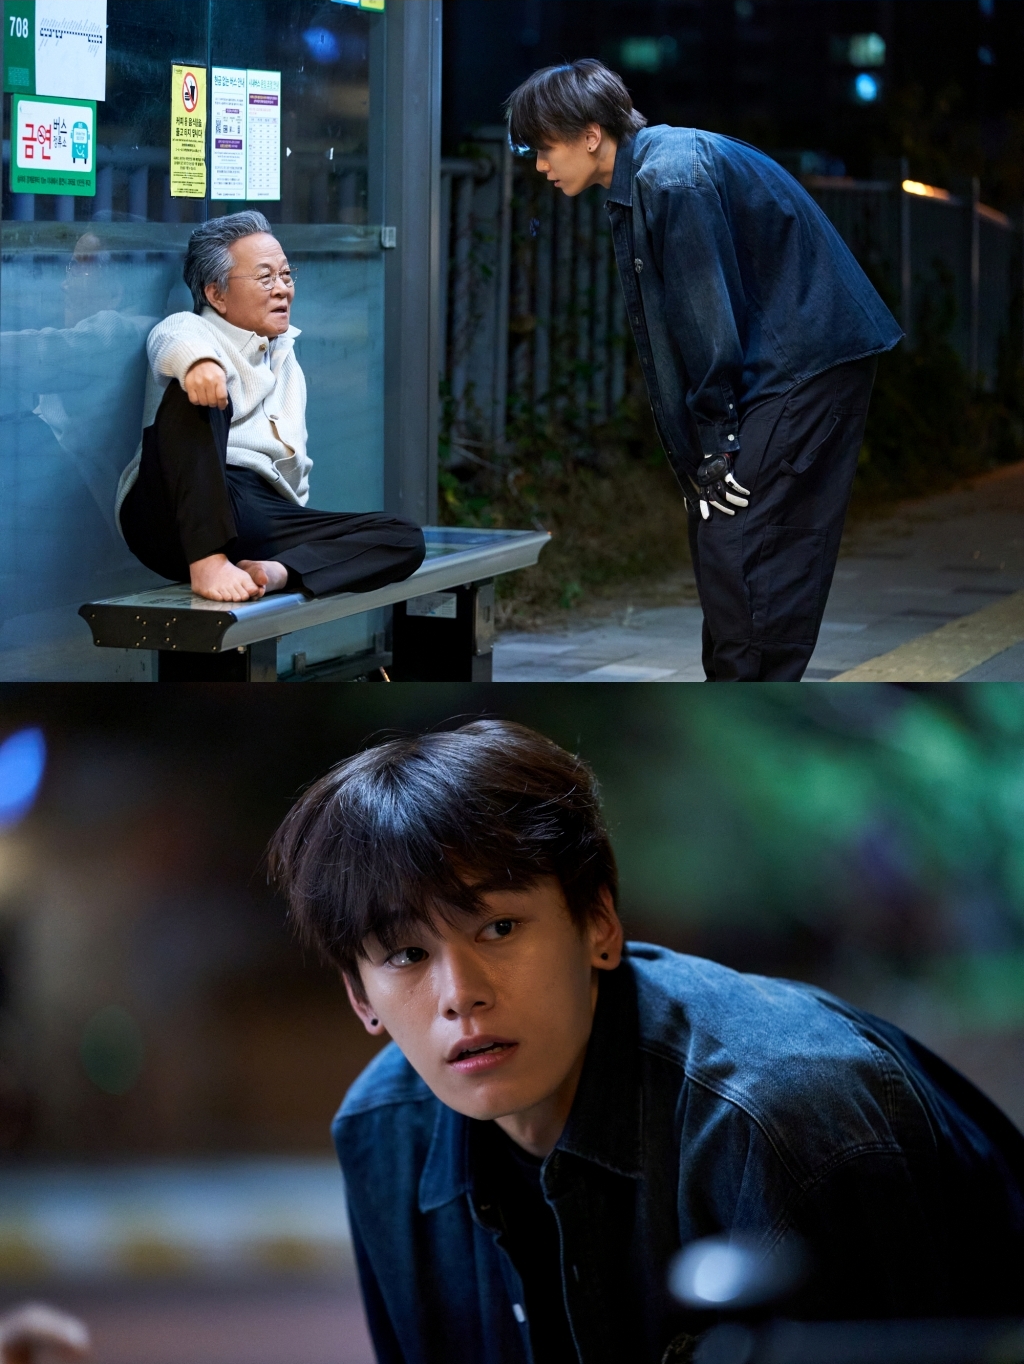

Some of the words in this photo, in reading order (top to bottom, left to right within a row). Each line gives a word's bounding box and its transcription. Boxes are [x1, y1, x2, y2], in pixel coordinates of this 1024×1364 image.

[9, 16, 29, 38] 708
[53, 117, 67, 135] 버스
[22, 123, 51, 160] 금연
